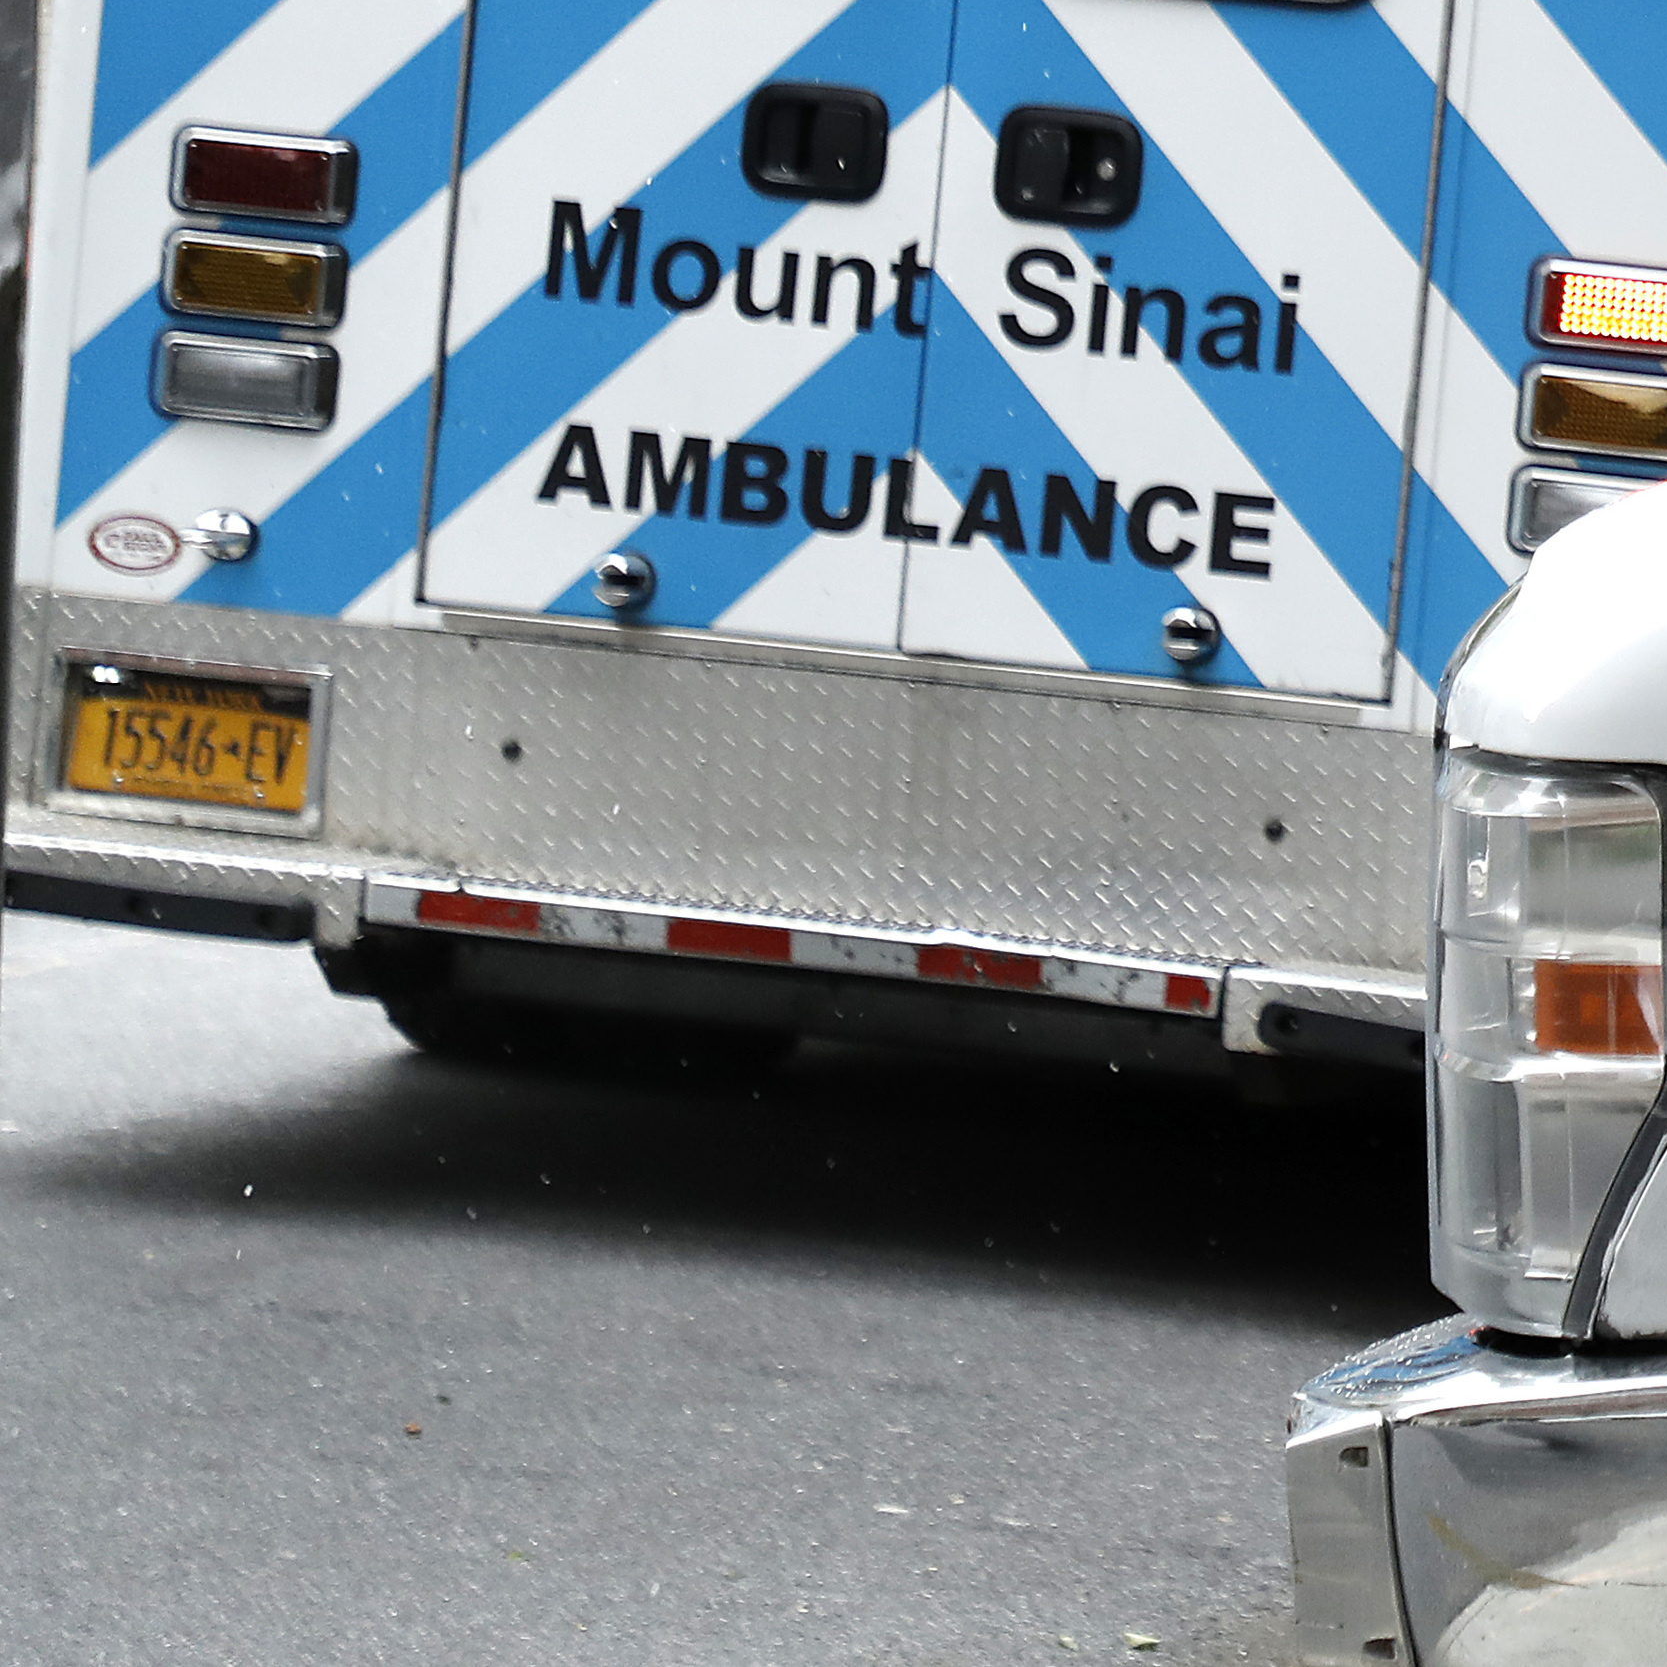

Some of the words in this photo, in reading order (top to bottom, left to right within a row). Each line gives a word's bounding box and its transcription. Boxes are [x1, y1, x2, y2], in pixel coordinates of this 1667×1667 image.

[542, 197, 935, 338] Mount
[999, 245, 1303, 376] Sinai
[535, 423, 1278, 580] AMBULANCE
